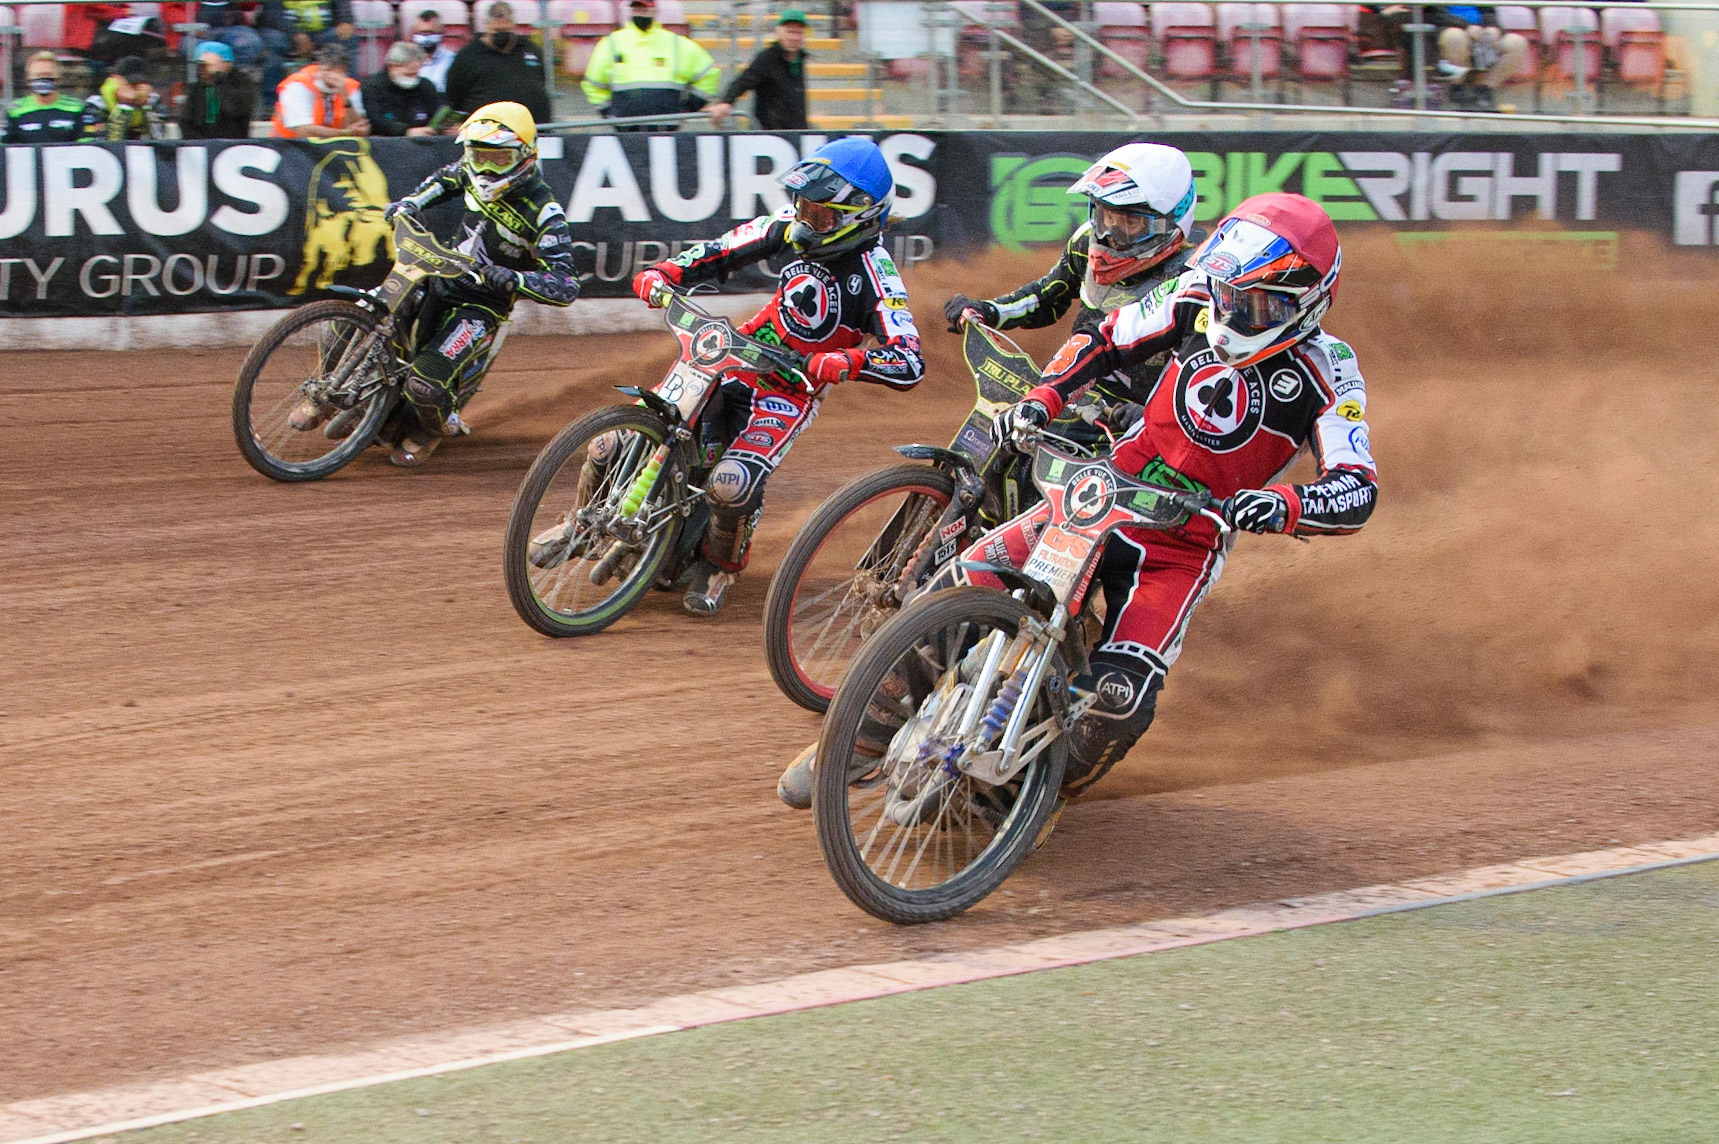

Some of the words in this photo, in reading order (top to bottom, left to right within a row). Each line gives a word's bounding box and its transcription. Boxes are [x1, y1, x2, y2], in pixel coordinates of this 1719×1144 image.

[79, 253, 286, 298] GROUP
[1205, 256, 1234, 273] STS
[784, 264, 810, 279] BELLE
[812, 267, 830, 284] VUE
[827, 286, 837, 314] ACES
[1249, 381, 1260, 414] ACES
[716, 472, 740, 485] ATPI
[941, 518, 964, 539] NGK
[1028, 558, 1077, 580] PREMIER
[1073, 576, 1090, 602] BLUE
[1087, 552, 1102, 578] DOOR
[1101, 681, 1130, 698] ATPI
